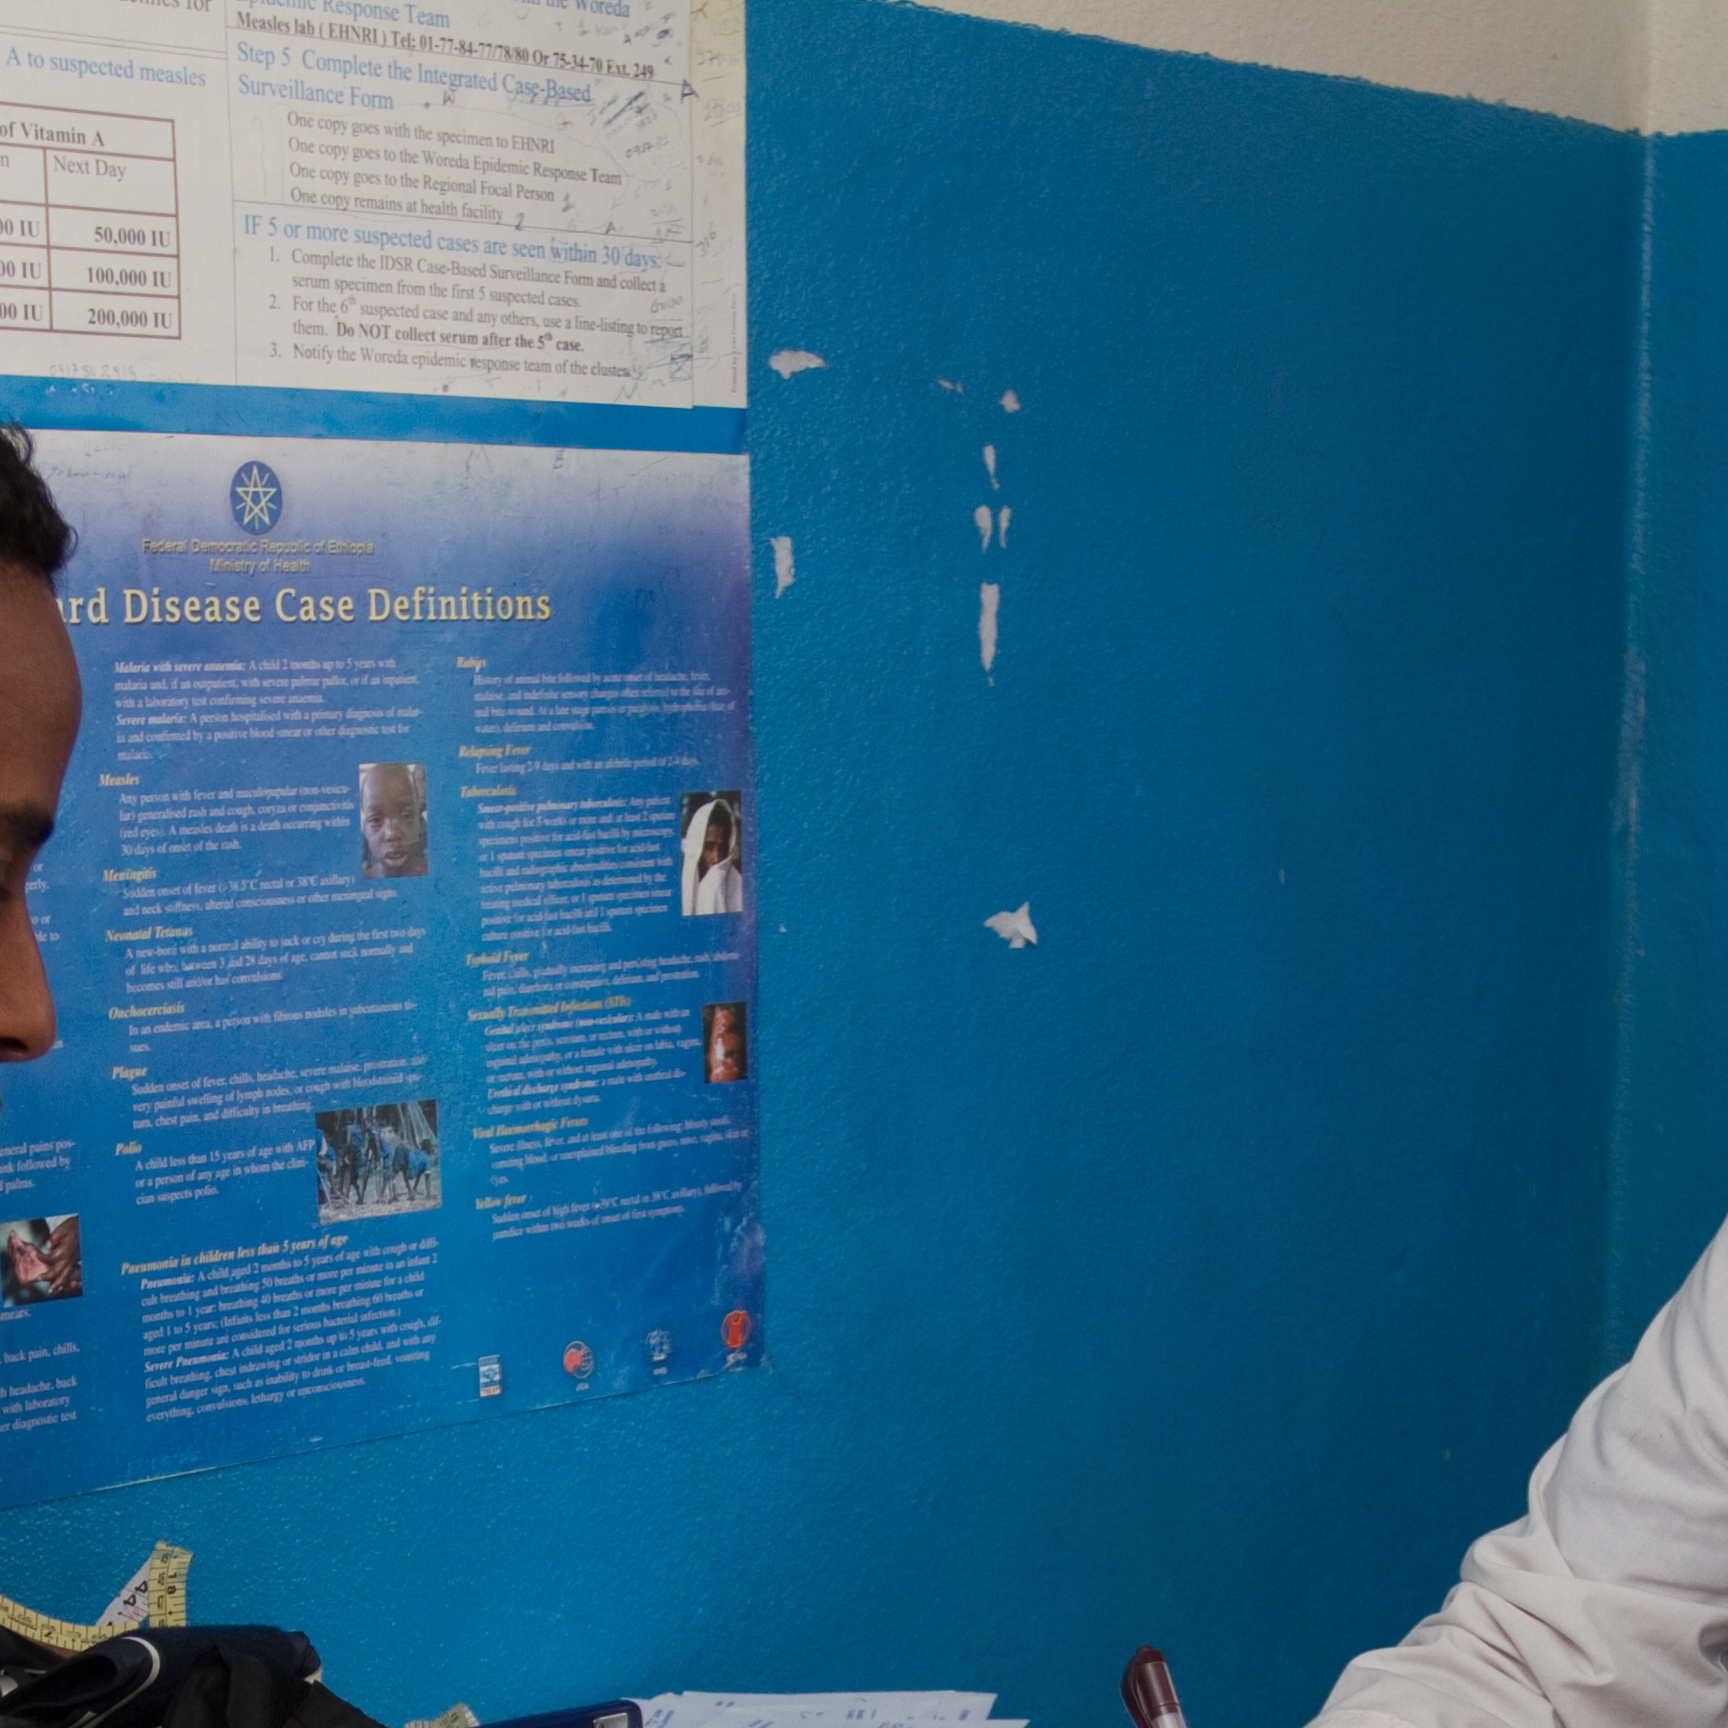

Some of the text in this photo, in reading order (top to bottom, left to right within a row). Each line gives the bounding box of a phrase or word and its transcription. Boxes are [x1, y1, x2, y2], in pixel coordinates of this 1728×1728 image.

[5, 46, 22, 67] A
[27, 51, 45, 70] to
[49, 56, 135, 80] suspected
[139, 65, 207, 88] measles
[237, 40, 591, 103] Step 5 Complete the Integrated Case-Based
[238, 77, 394, 111] Surveillance Form
[20, 121, 87, 146] Vitamin
[91, 130, 105, 147] A
[53, 154, 127, 181] Next Day
[19, 219, 40, 238] IU
[87, 266, 171, 289] 100,000 IU
[23, 303, 43, 322] IU
[142, 538, 374, 556] Federal Democratic Republic of Ethiopia
[210, 558, 311, 575] Ministry of Health
[123, 586, 262, 624] Disease
[274, 588, 355, 622] Case
[367, 587, 552, 621] Definitions
[97, 772, 140, 787] Measles
[102, 866, 158, 883] Meningitis
[108, 1001, 186, 1019] Onchocerciasis
[111, 1065, 149, 1081] Plague
[114, 1140, 143, 1156] Polio
[134, 1139, 316, 1172] A child less than 15 years of age with AFP
